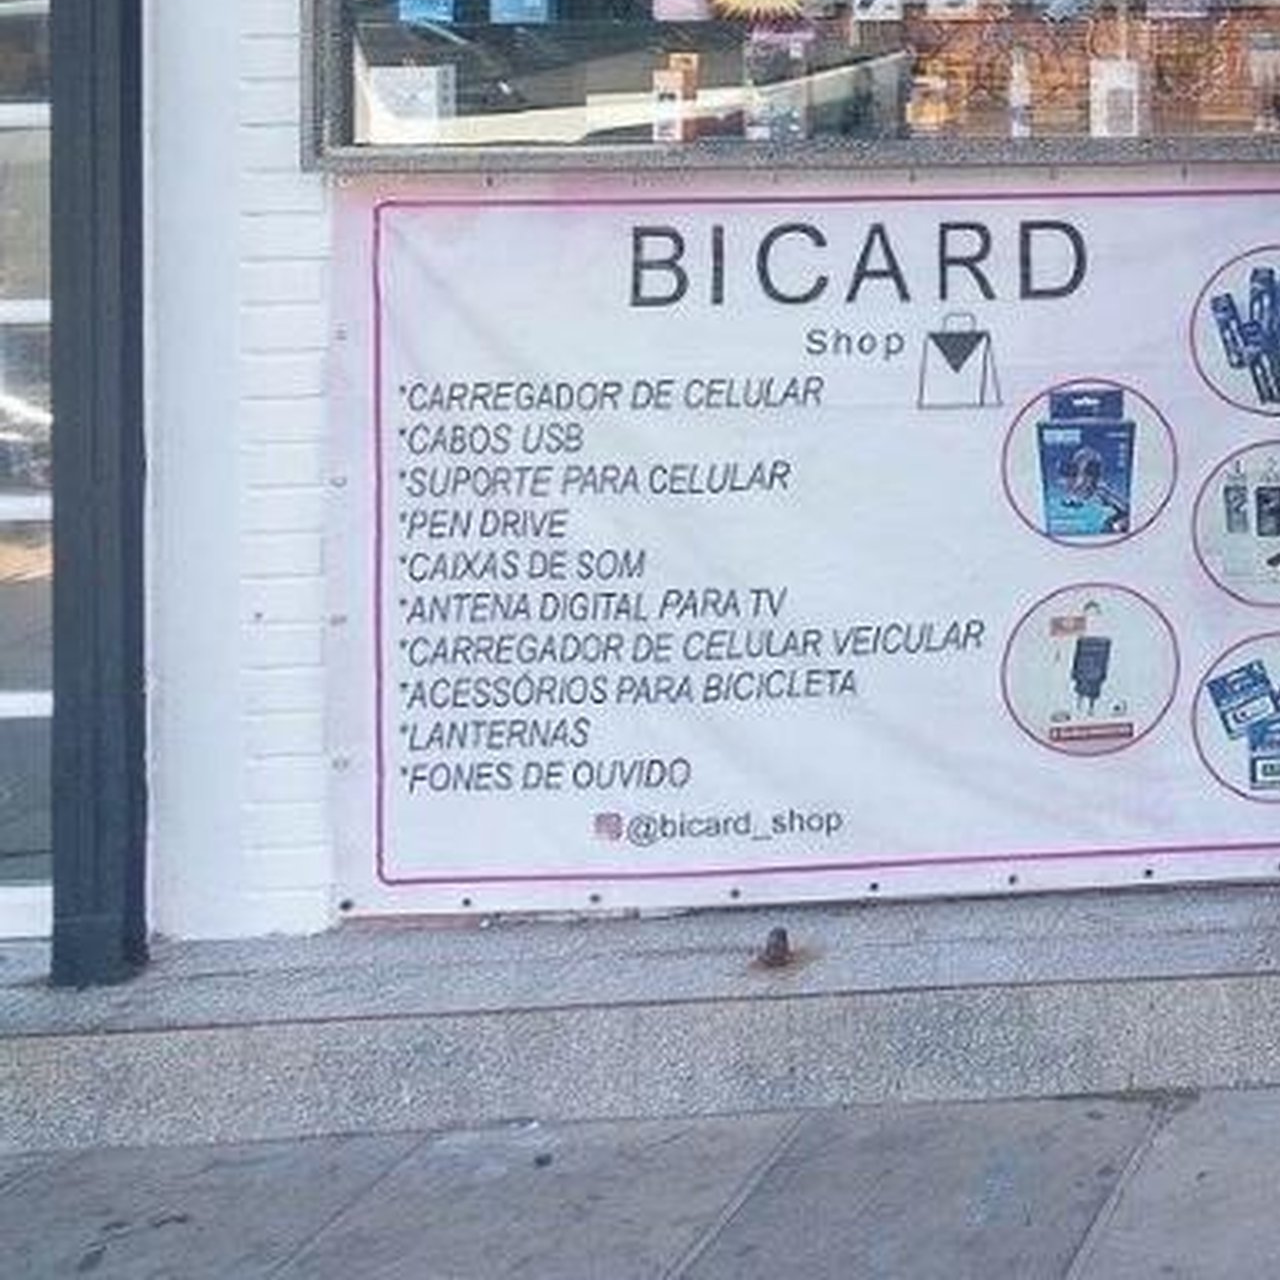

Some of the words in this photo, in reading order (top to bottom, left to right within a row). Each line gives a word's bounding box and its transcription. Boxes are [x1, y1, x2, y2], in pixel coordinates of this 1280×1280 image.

[630, 220, 1087, 308] BICARD
[805, 328, 906, 362] Shop
[629, 379, 676, 411] DE
[683, 375, 825, 410] CELULAR
[521, 422, 585, 455] USB
[560, 463, 641, 496] PARA
[648, 459, 792, 495] CELULAR
[479, 508, 570, 539] DRIVE
[526, 549, 568, 581] DE
[575, 548, 647, 581] SOM
[539, 591, 648, 623] DIGITAL
[658, 587, 741, 620] PARA
[749, 586, 788, 618] TV
[631, 632, 675, 665] DE
[682, 628, 824, 662] CELULAR
[832, 619, 986, 657] VEICULAR
[615, 674, 695, 705] PARA
[701, 668, 857, 704] BICICLETA
[521, 759, 566, 791] DE
[572, 756, 692, 791] OUVIDO
[625, 808, 844, 848] @bicard_shop
